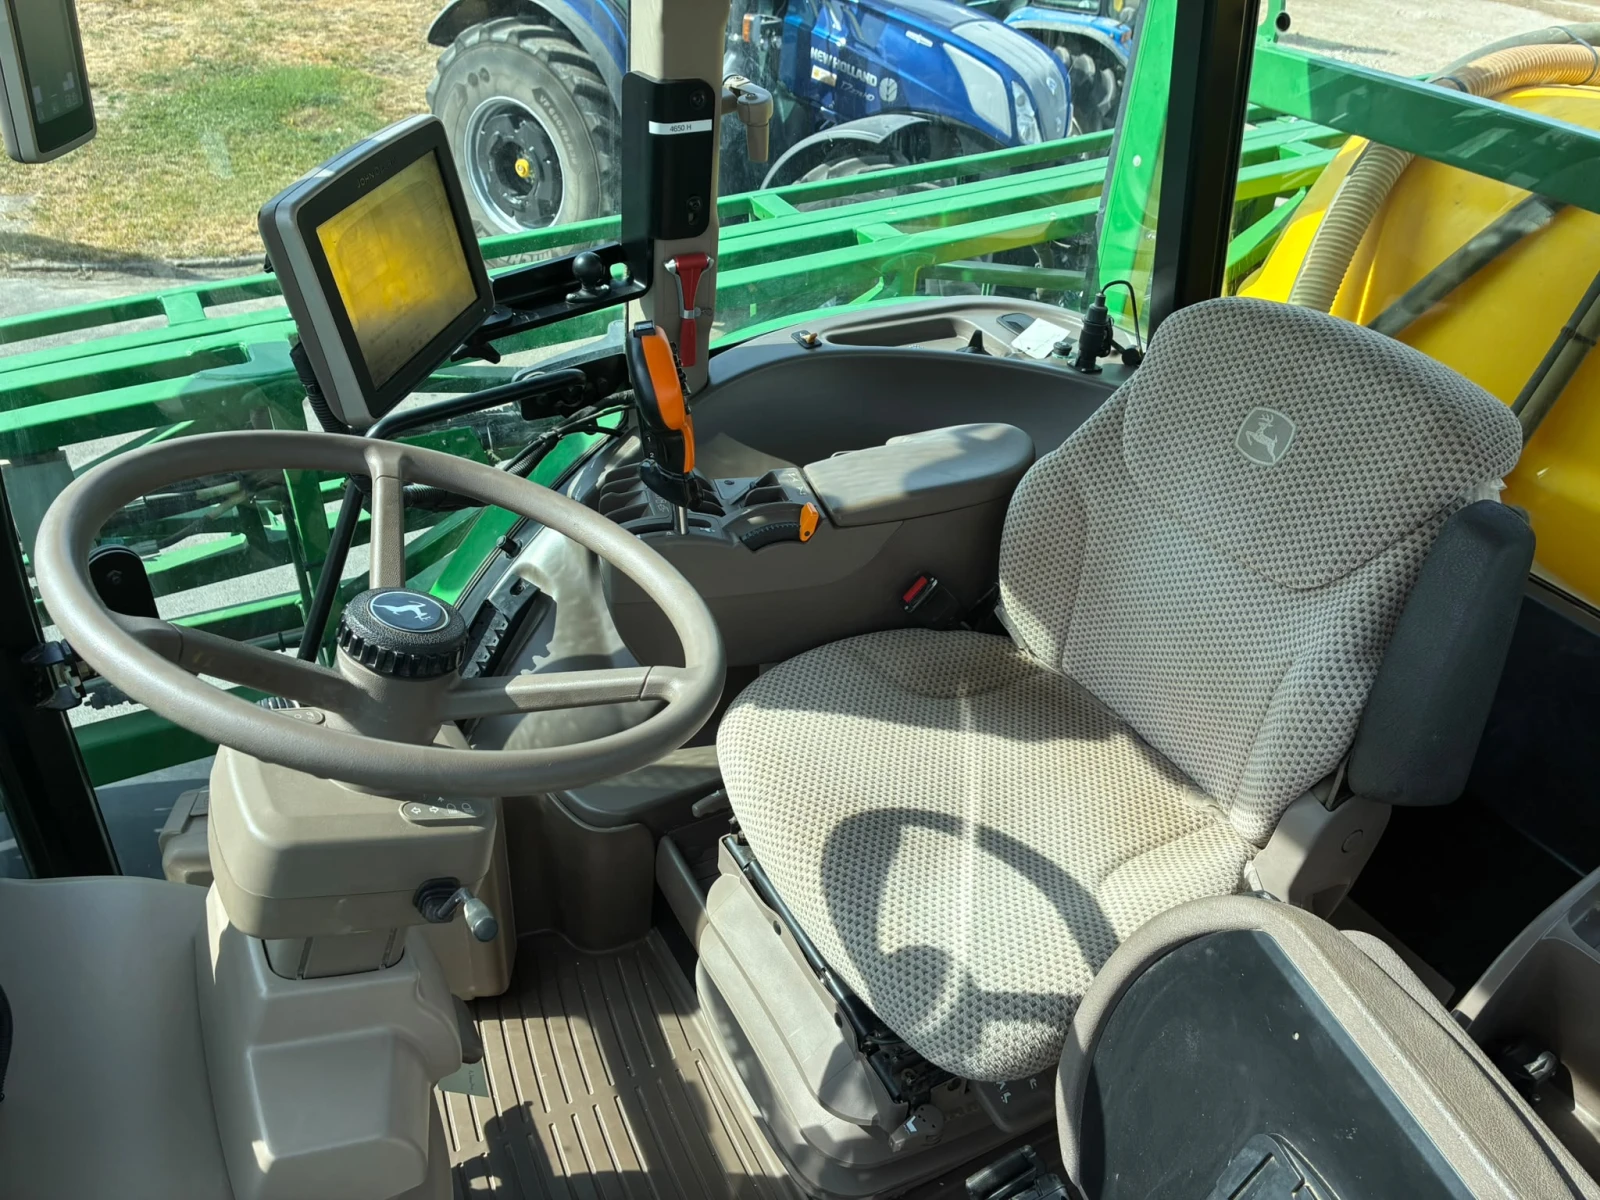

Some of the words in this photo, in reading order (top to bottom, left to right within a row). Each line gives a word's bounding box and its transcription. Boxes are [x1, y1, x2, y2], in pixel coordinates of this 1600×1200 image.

[810, 46, 833, 66] NEW
[832, 56, 877, 88] HOLLAND
[357, 172, 375, 189] JOHN
